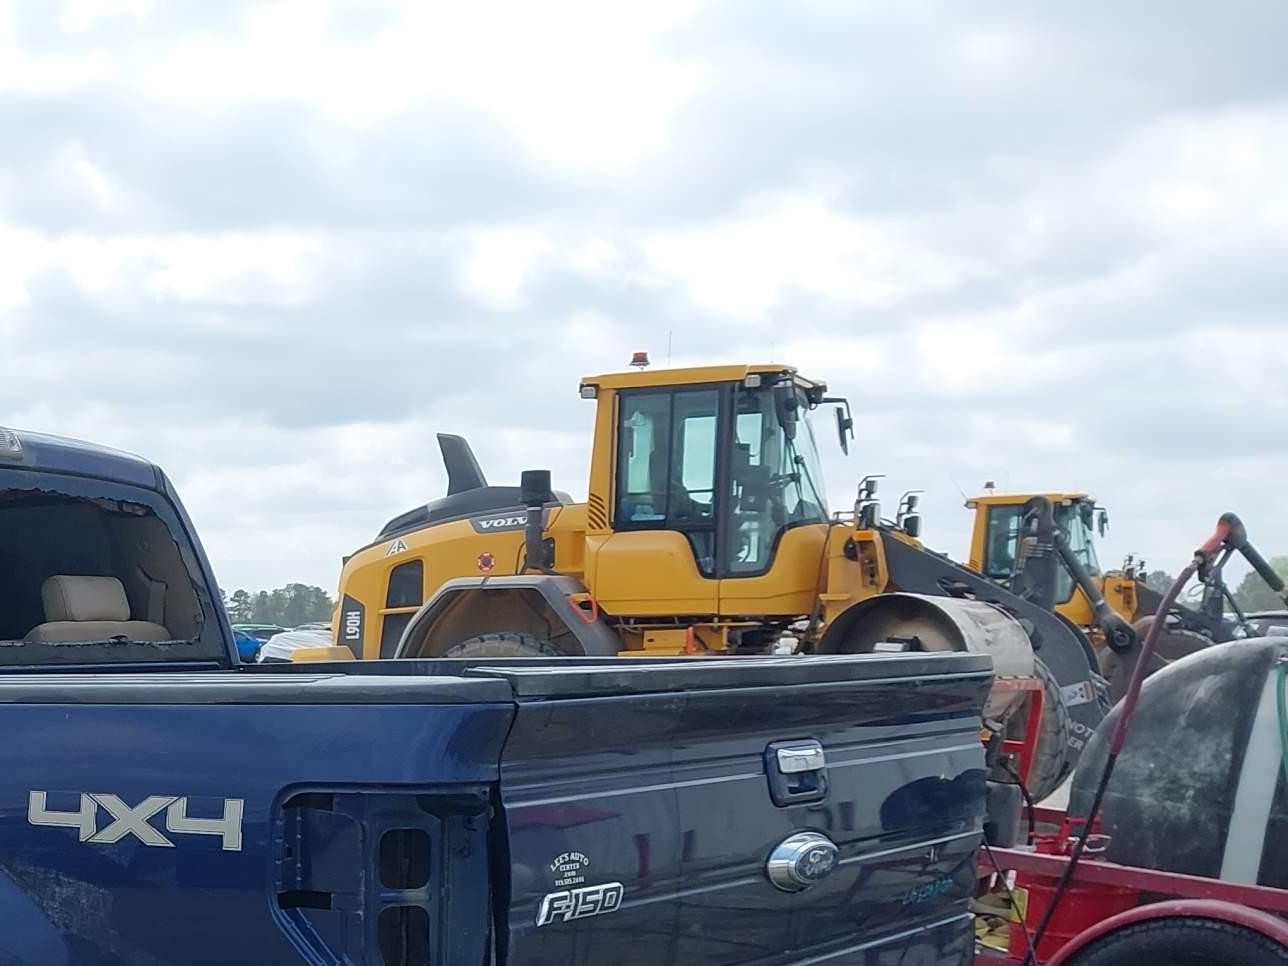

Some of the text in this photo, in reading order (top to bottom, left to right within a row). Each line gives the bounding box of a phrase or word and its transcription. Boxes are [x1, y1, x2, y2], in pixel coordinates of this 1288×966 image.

[479, 516, 529, 529] VOLV
[345, 611, 361, 640] L90H
[570, 852, 589, 866] AUTO
